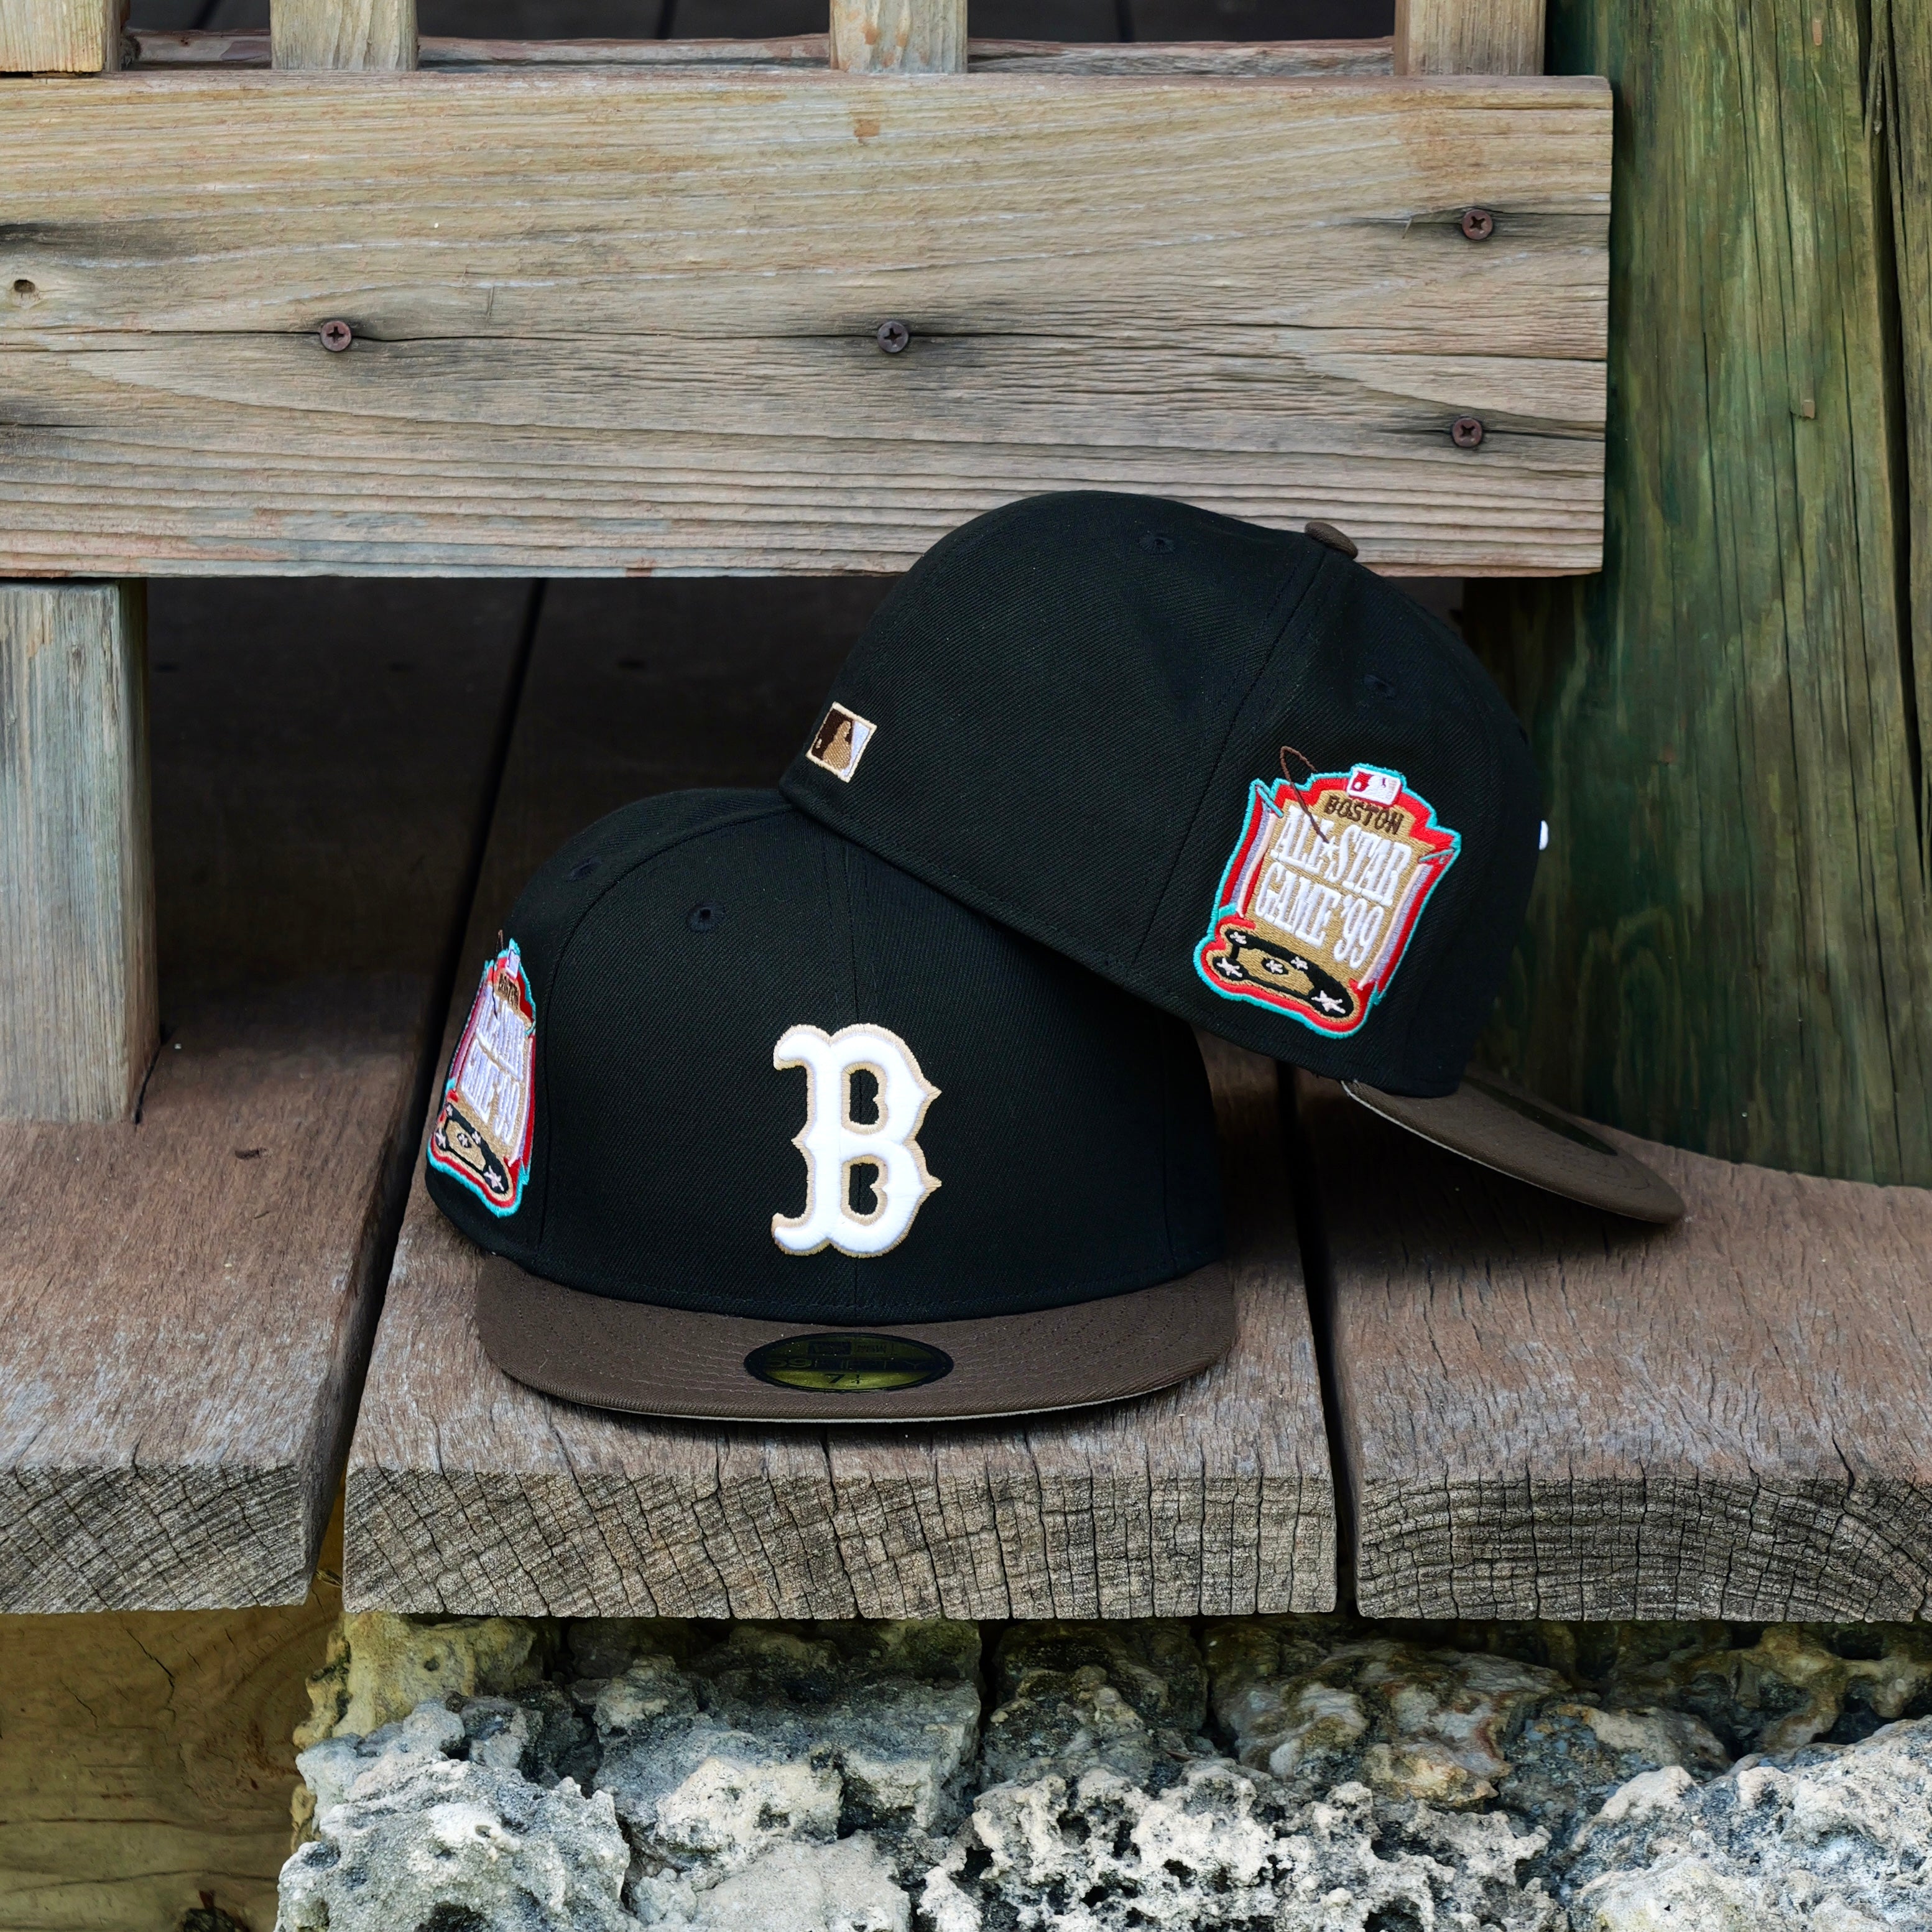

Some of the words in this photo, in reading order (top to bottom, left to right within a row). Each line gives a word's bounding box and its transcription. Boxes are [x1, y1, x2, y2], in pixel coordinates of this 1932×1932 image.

[1324, 795, 1403, 835] BOSTON
[1255, 861, 1341, 948] GAME
[771, 1024, 942, 1259] B
